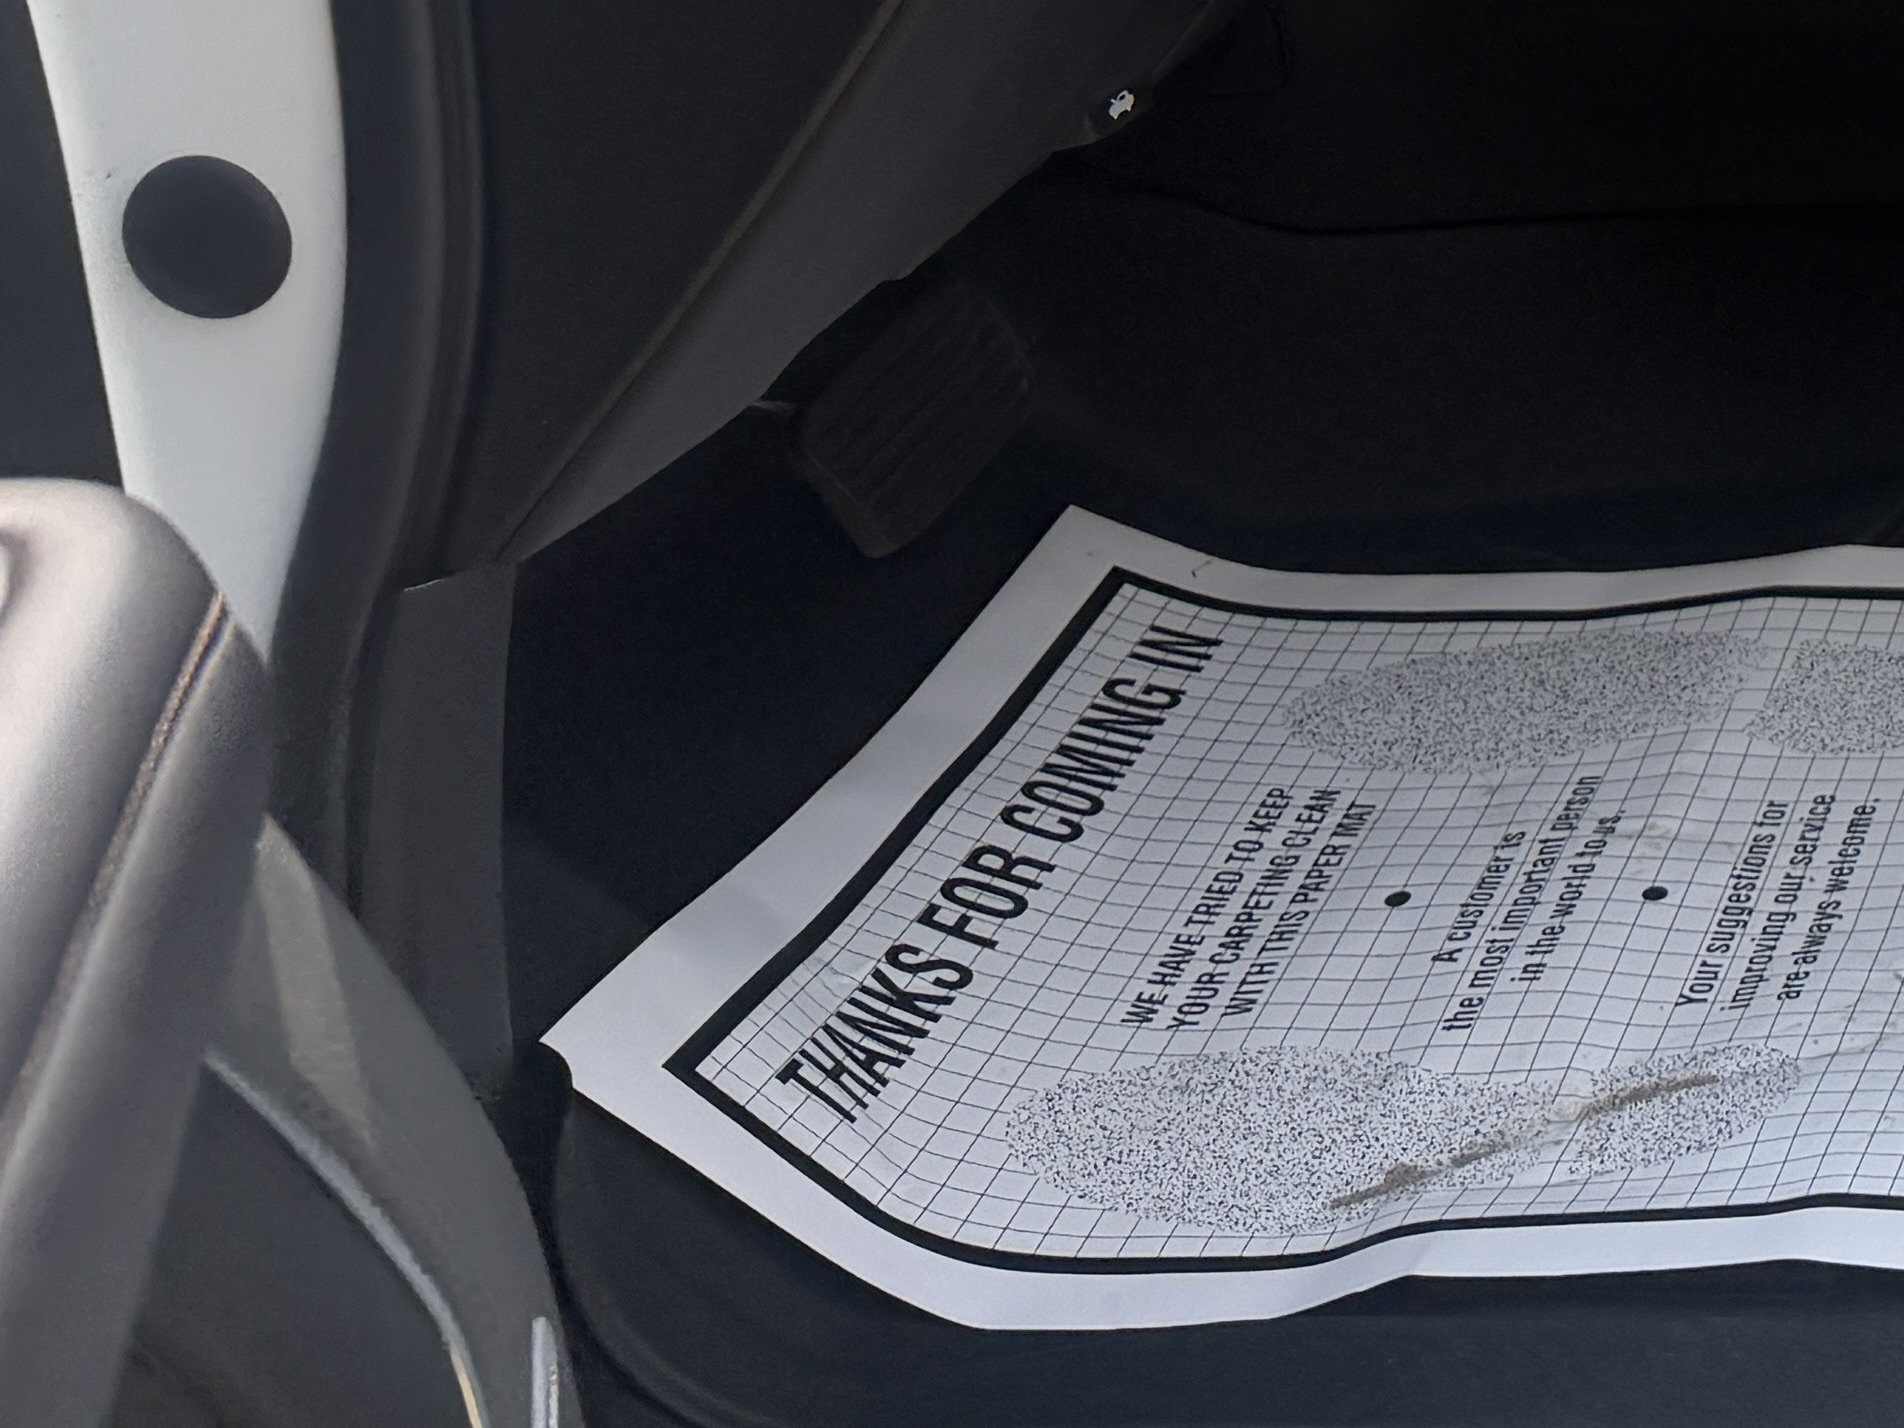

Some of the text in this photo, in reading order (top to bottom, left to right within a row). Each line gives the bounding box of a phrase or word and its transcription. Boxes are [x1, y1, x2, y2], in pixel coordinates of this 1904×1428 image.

[774, 624, 1225, 1124] THANKS FOR COMING IN
[1120, 787, 1294, 1024] WE HAVE TRIED TO KEEP
[1166, 789, 1342, 1030] YOUR CARPETING CLEAN
[1221, 800, 1377, 1017] WITH THIS PAPER MAT
[1431, 830, 1527, 964] A customer is
[1441, 775, 1604, 1032] the most important person
[1549, 862, 1597, 920] world
[1575, 838, 1608, 861] to
[1674, 800, 1791, 1007] Your suggestions for
[1719, 794, 1837, 1012] improving our service
[1791, 899, 1845, 966] always
[1510, 962, 1548, 983] in
[1524, 923, 1566, 957] the
[1776, 970, 1811, 1002] are
